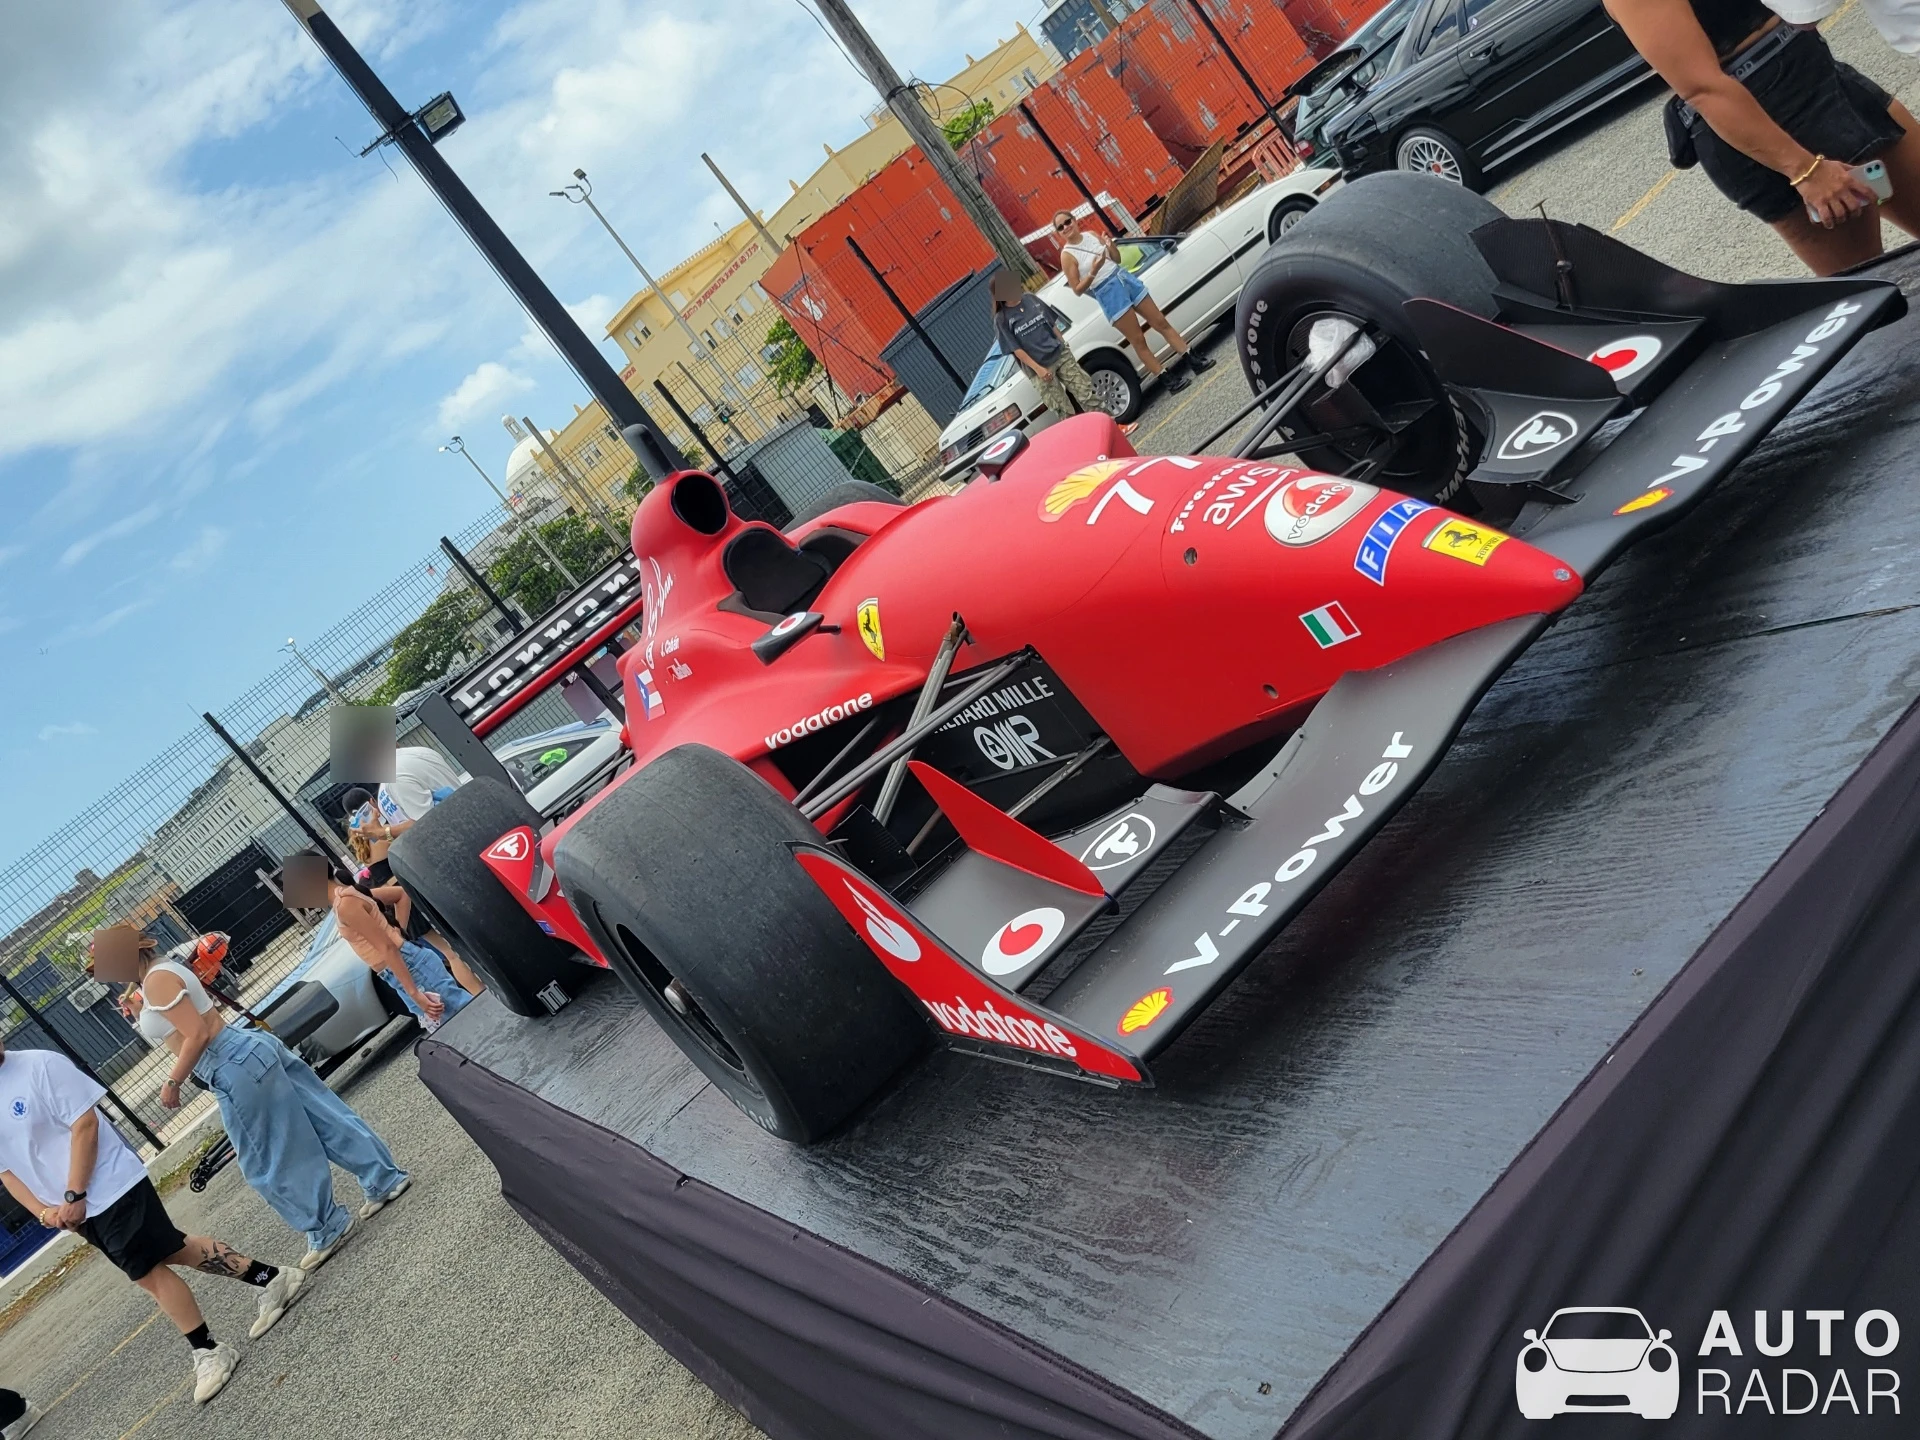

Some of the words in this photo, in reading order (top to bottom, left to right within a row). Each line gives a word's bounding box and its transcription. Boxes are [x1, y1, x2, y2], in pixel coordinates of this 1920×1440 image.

[1647, 302, 1863, 489] V-Power
[1086, 455, 1203, 525] 77
[1203, 466, 1279, 525] aws
[1361, 502, 1423, 573] FIA
[764, 692, 873, 750] vodafone
[991, 675, 1054, 711] MILLE
[1163, 731, 1413, 975] V-Power
[922, 995, 1078, 1057] vodafone
